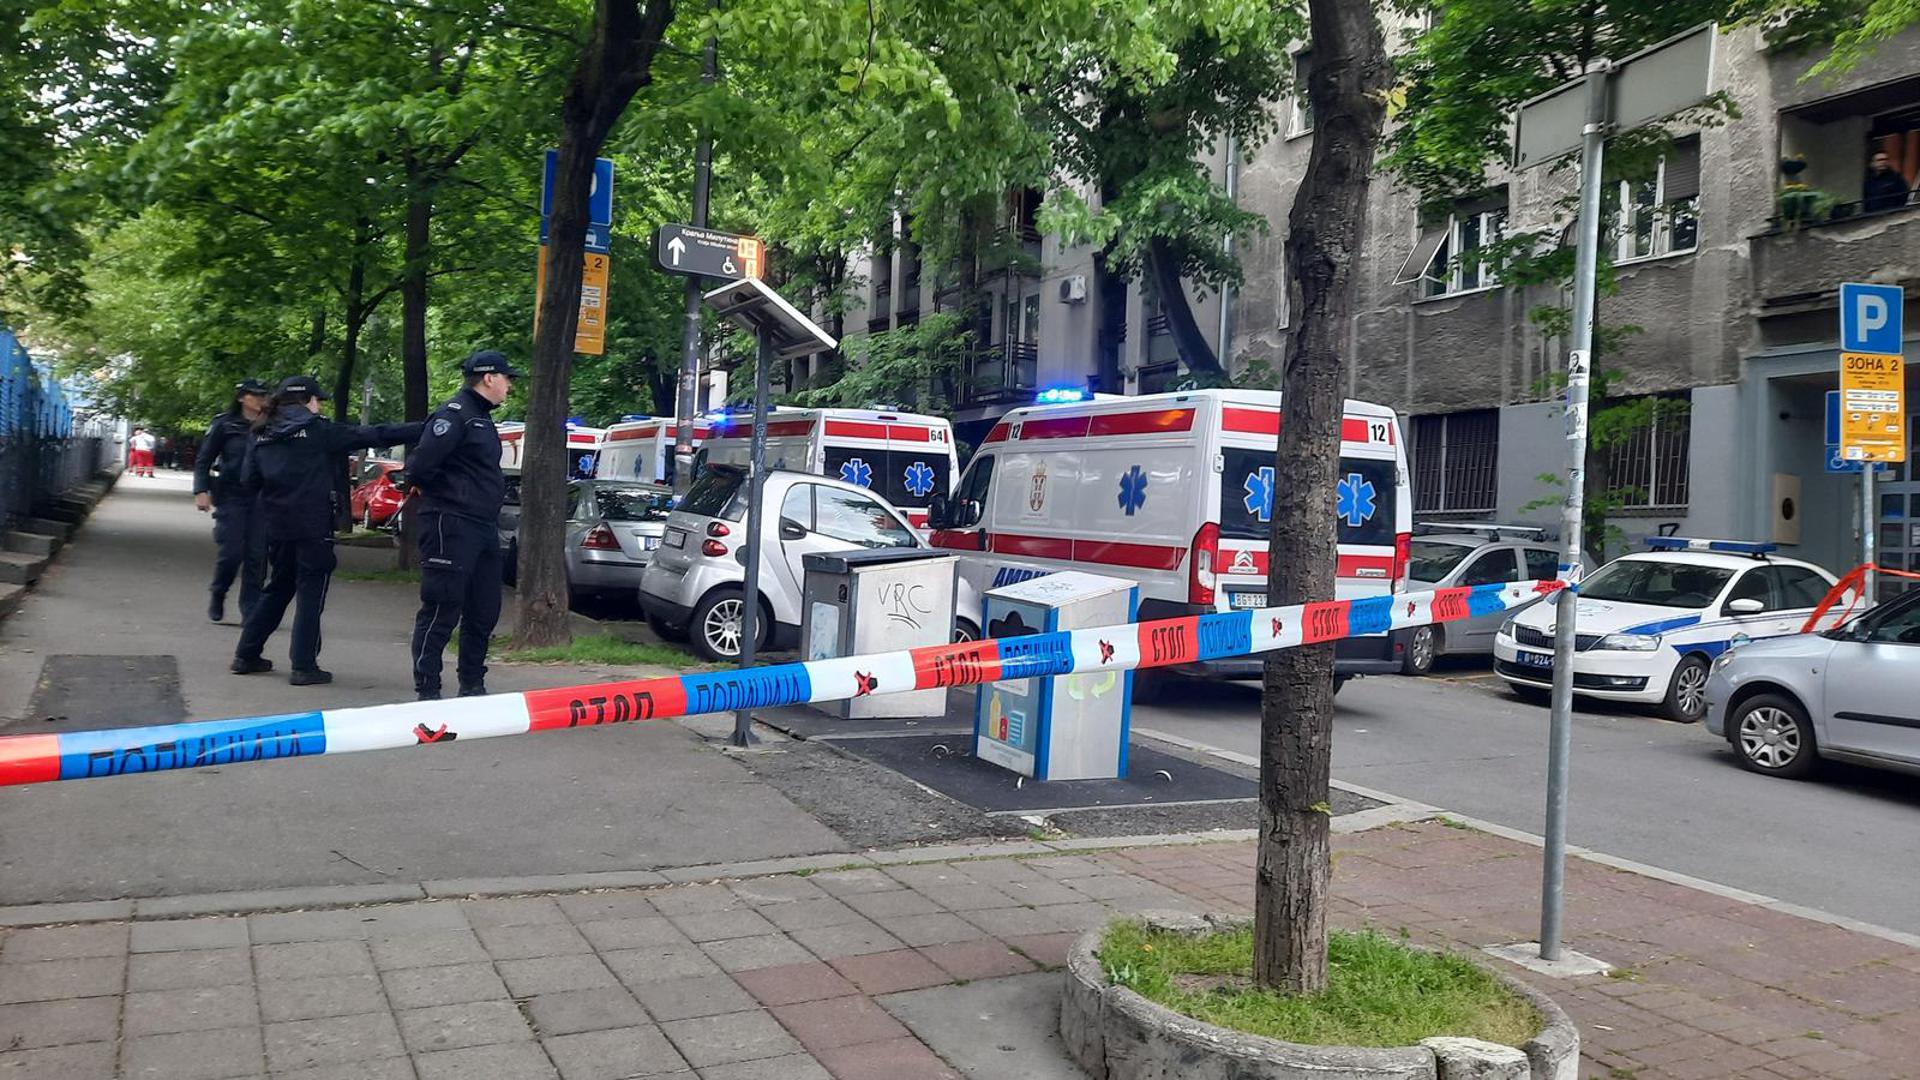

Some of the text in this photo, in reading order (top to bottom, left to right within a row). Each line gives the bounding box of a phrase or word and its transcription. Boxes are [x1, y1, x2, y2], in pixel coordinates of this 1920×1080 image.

[594, 257, 603, 269] 2
[1857, 294, 1888, 343] P
[1847, 356, 1899, 371] ЗОНА 2
[930, 430, 943, 441] 64
[1011, 423, 1021, 439] 12
[1370, 424, 1386, 441] 12
[878, 583, 932, 619] VRC
[1312, 607, 1341, 638] СТОП
[1152, 624, 1186, 662] СТОП
[935, 650, 983, 687] СТОП
[568, 690, 655, 727] СТОП
